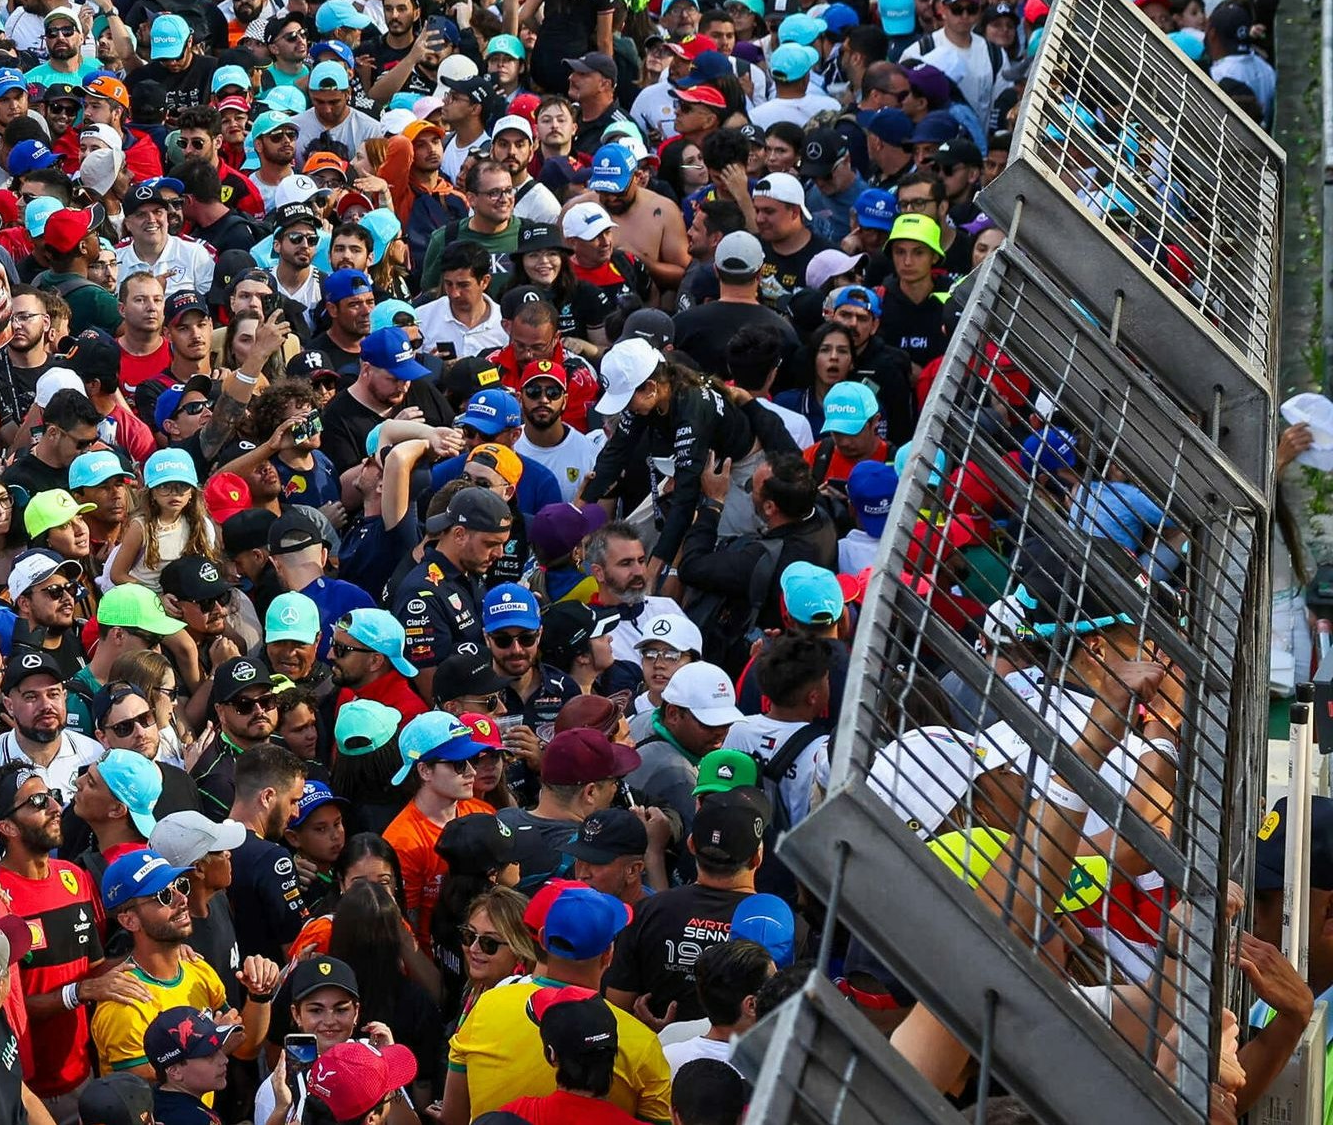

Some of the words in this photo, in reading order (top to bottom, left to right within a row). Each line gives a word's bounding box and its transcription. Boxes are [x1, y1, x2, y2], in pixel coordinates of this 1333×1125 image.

[491, 604, 527, 613] NACIONAL
[687, 917, 733, 932] AYRTO
[683, 927, 731, 943] SENN
[665, 939, 713, 965] 19
